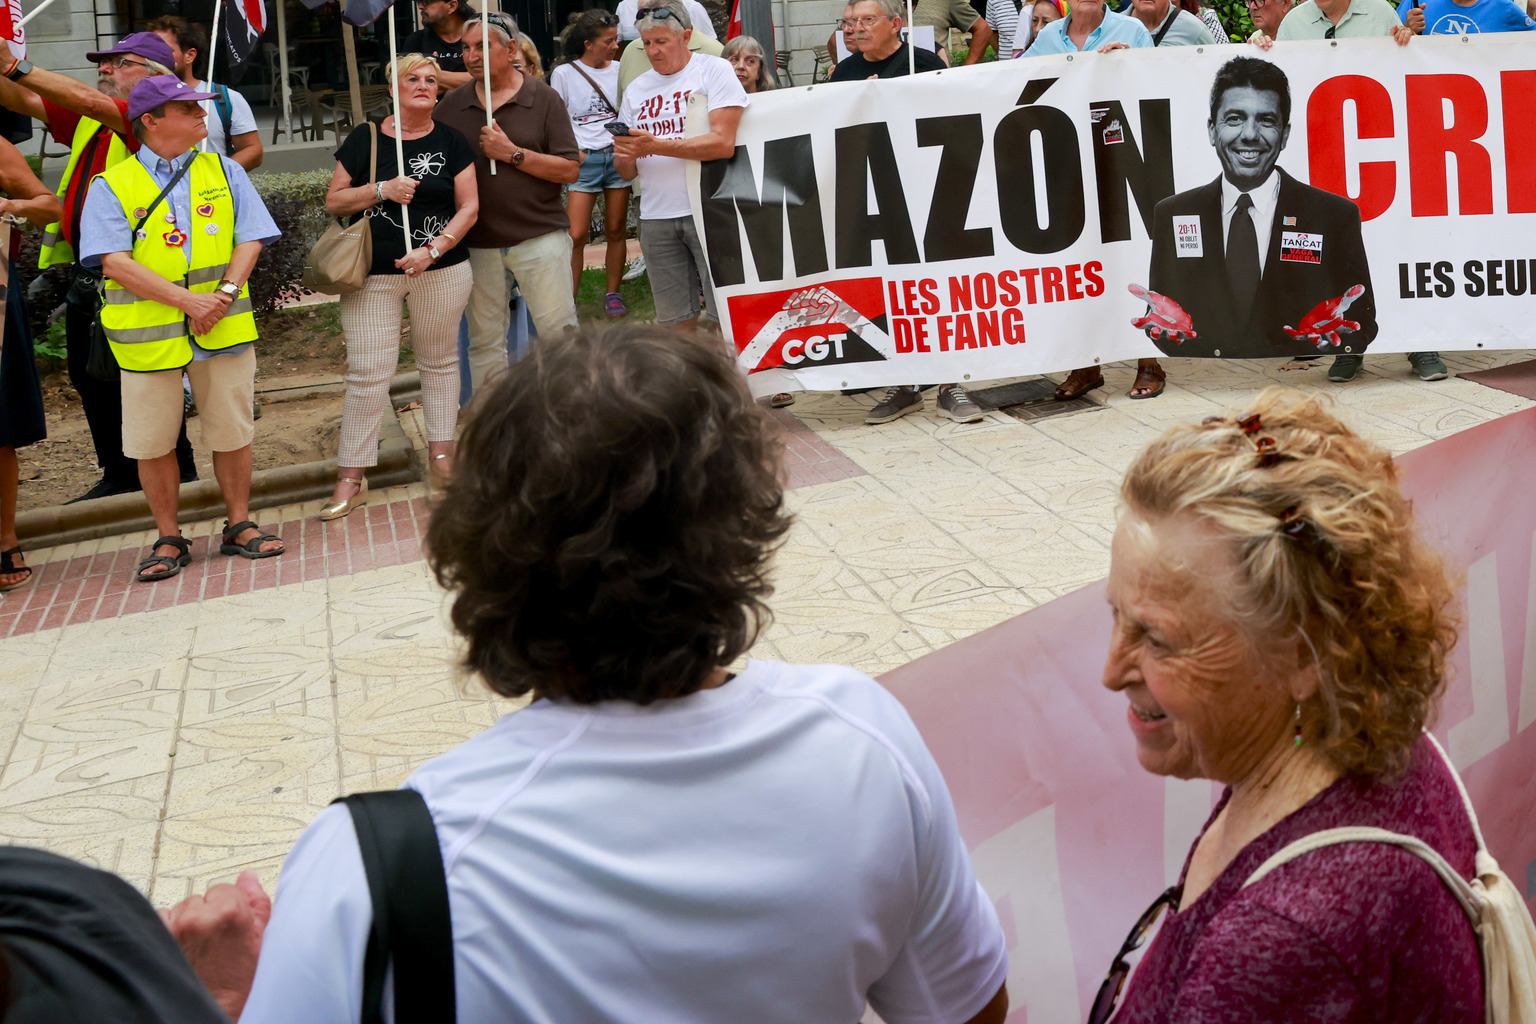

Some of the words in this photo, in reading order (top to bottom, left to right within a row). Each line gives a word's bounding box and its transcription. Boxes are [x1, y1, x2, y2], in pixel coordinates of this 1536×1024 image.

[701, 77, 1175, 288] MAZÓN
[1178, 224, 1197, 235] 20:11
[1283, 238, 1322, 248] TANCAT
[1281, 253, 1321, 263] GENERAL
[1290, 248, 1313, 256] VAGA
[887, 278, 940, 317] LES
[949, 260, 1105, 313] NOSTRES
[1399, 261, 1455, 299] LES
[893, 316, 929, 354] DE
[937, 307, 1027, 352] FANG
[781, 332, 848, 365] CGT
